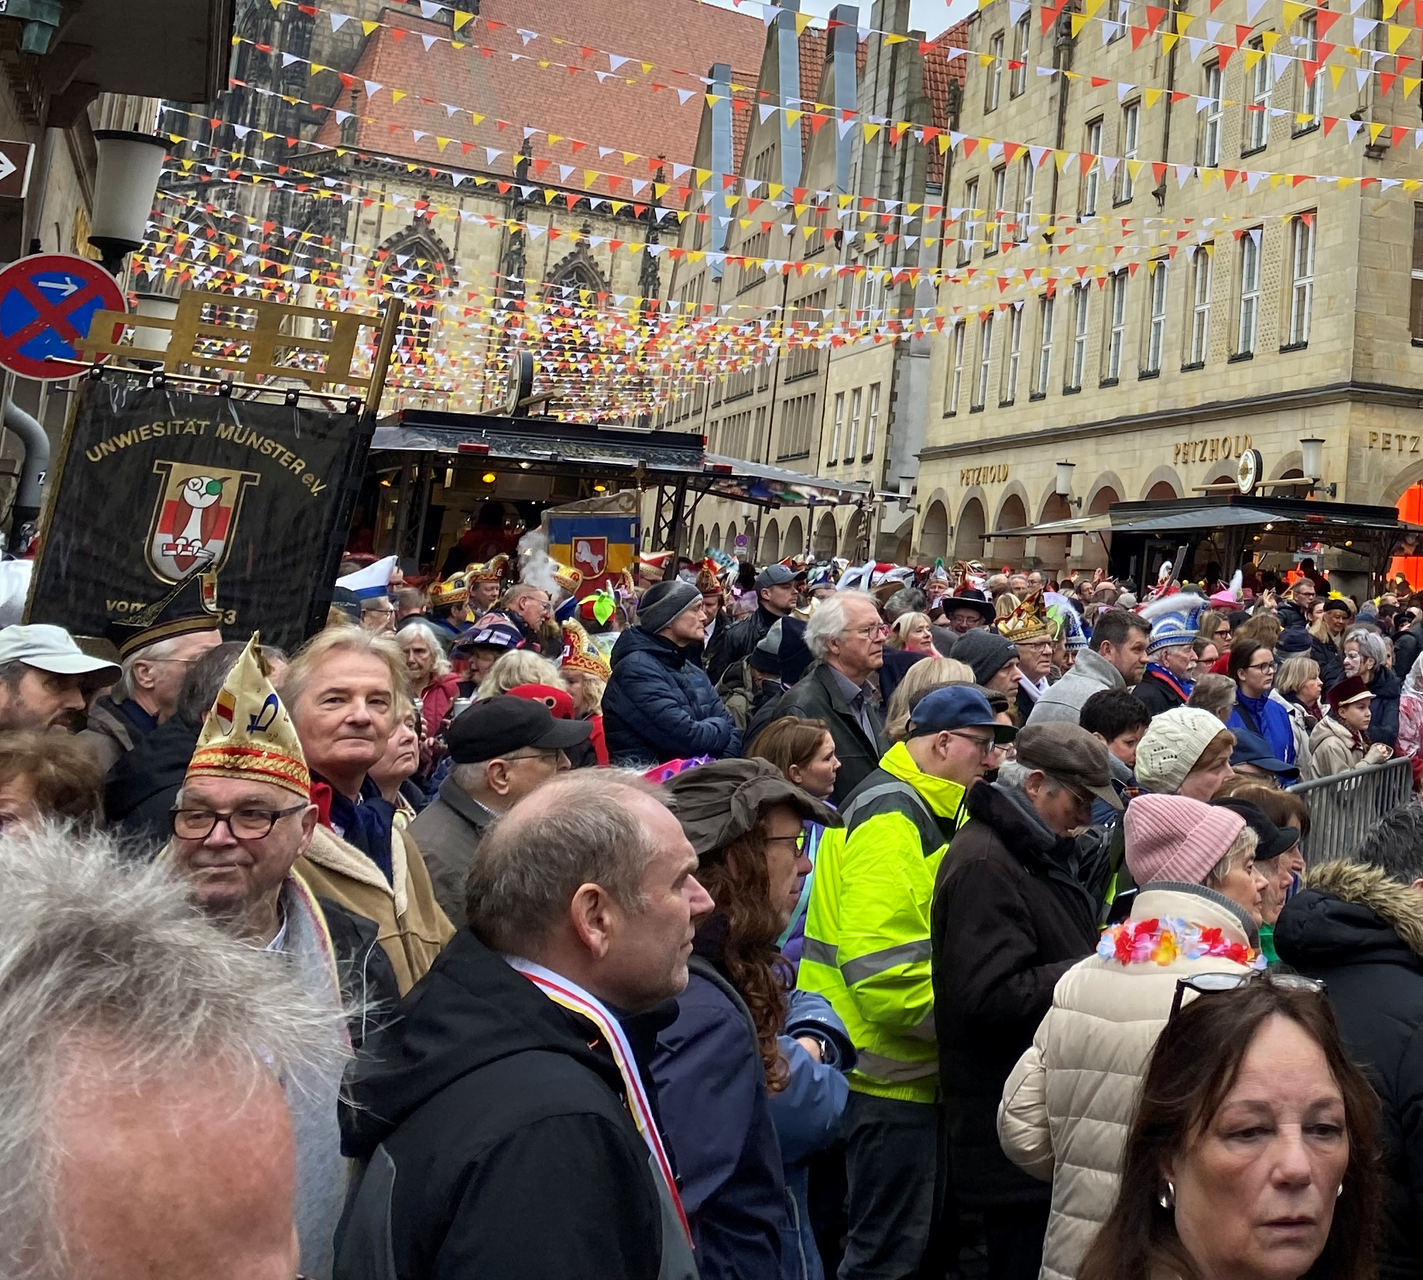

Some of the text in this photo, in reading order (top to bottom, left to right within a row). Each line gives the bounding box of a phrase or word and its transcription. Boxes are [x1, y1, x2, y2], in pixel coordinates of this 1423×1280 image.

[86, 417, 210, 463] UNWIESITÄT
[215, 422, 306, 476] MÜNSTER
[1173, 434, 1253, 465] PETZHOLD
[960, 463, 1009, 487] PETZHOLD
